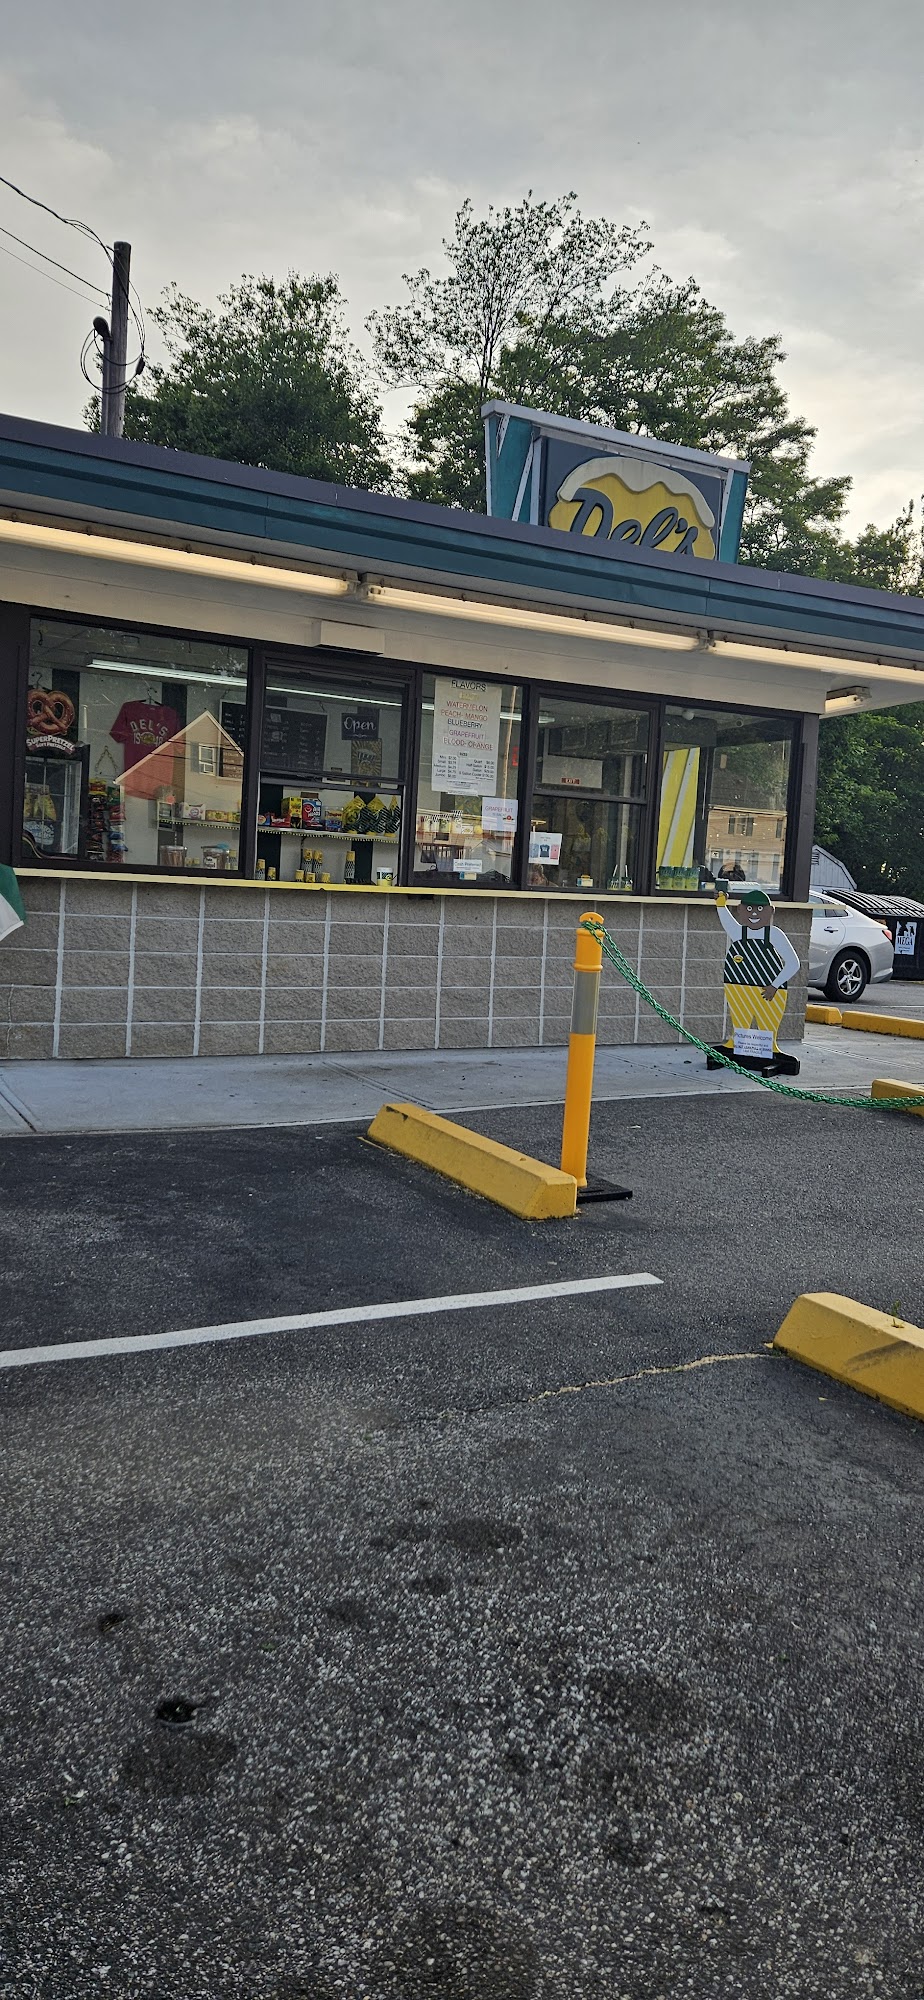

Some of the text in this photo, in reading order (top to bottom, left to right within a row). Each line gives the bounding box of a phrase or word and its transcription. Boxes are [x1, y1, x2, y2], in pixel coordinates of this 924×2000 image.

[570, 487, 699, 557] Del's
[451, 679, 487, 692] FLAVORS
[447, 700, 488, 712] WATERMELON
[130, 719, 169, 736] DEL'S
[344, 717, 377, 733] Open
[448, 719, 483, 728] BLUEBERRY
[449, 730, 484, 740] GRAPEFRUIT
[25, 735, 76, 752] SUPERPRETZEL
[468, 741, 494, 750] ORANGE
[898, 937, 913, 945] MEGA
